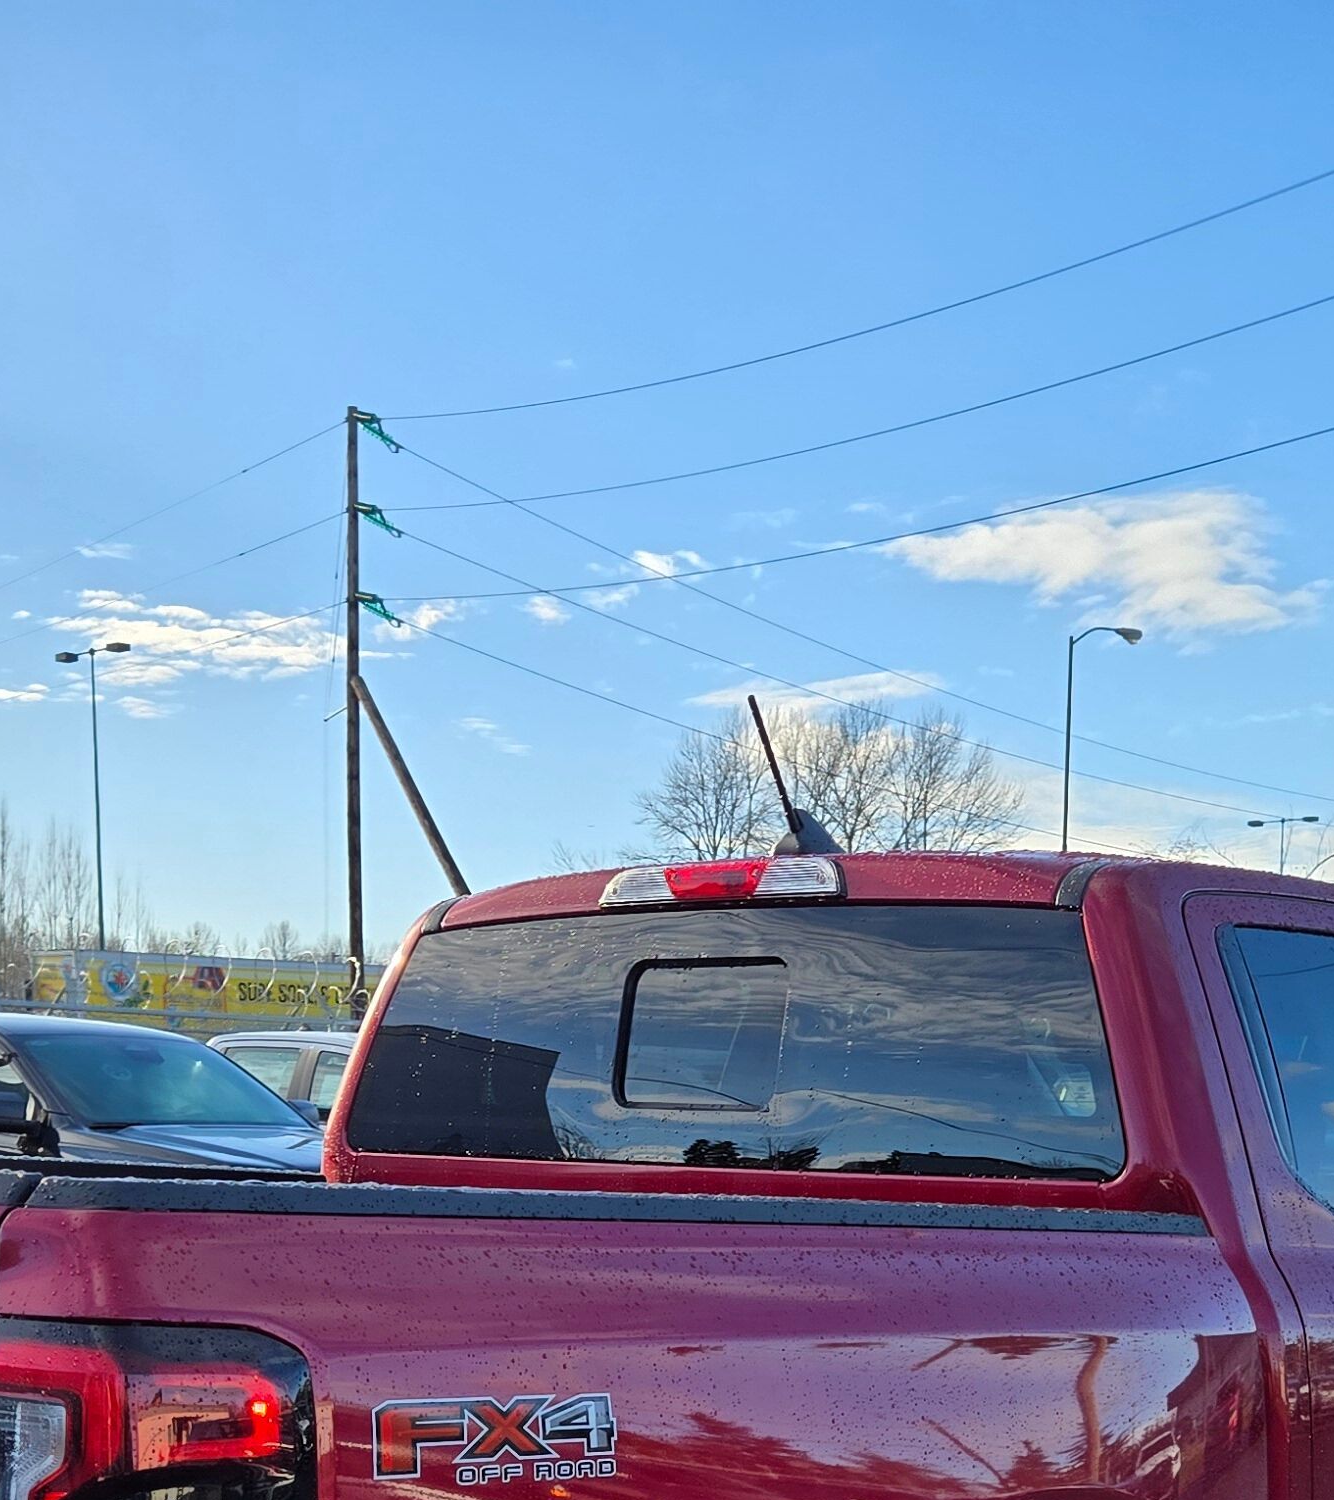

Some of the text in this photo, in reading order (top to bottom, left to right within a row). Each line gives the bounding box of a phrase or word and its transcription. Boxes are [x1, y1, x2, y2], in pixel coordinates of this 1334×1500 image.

[371, 1392, 618, 1481] FX4
[455, 1459, 617, 1486] OFF ROAD
